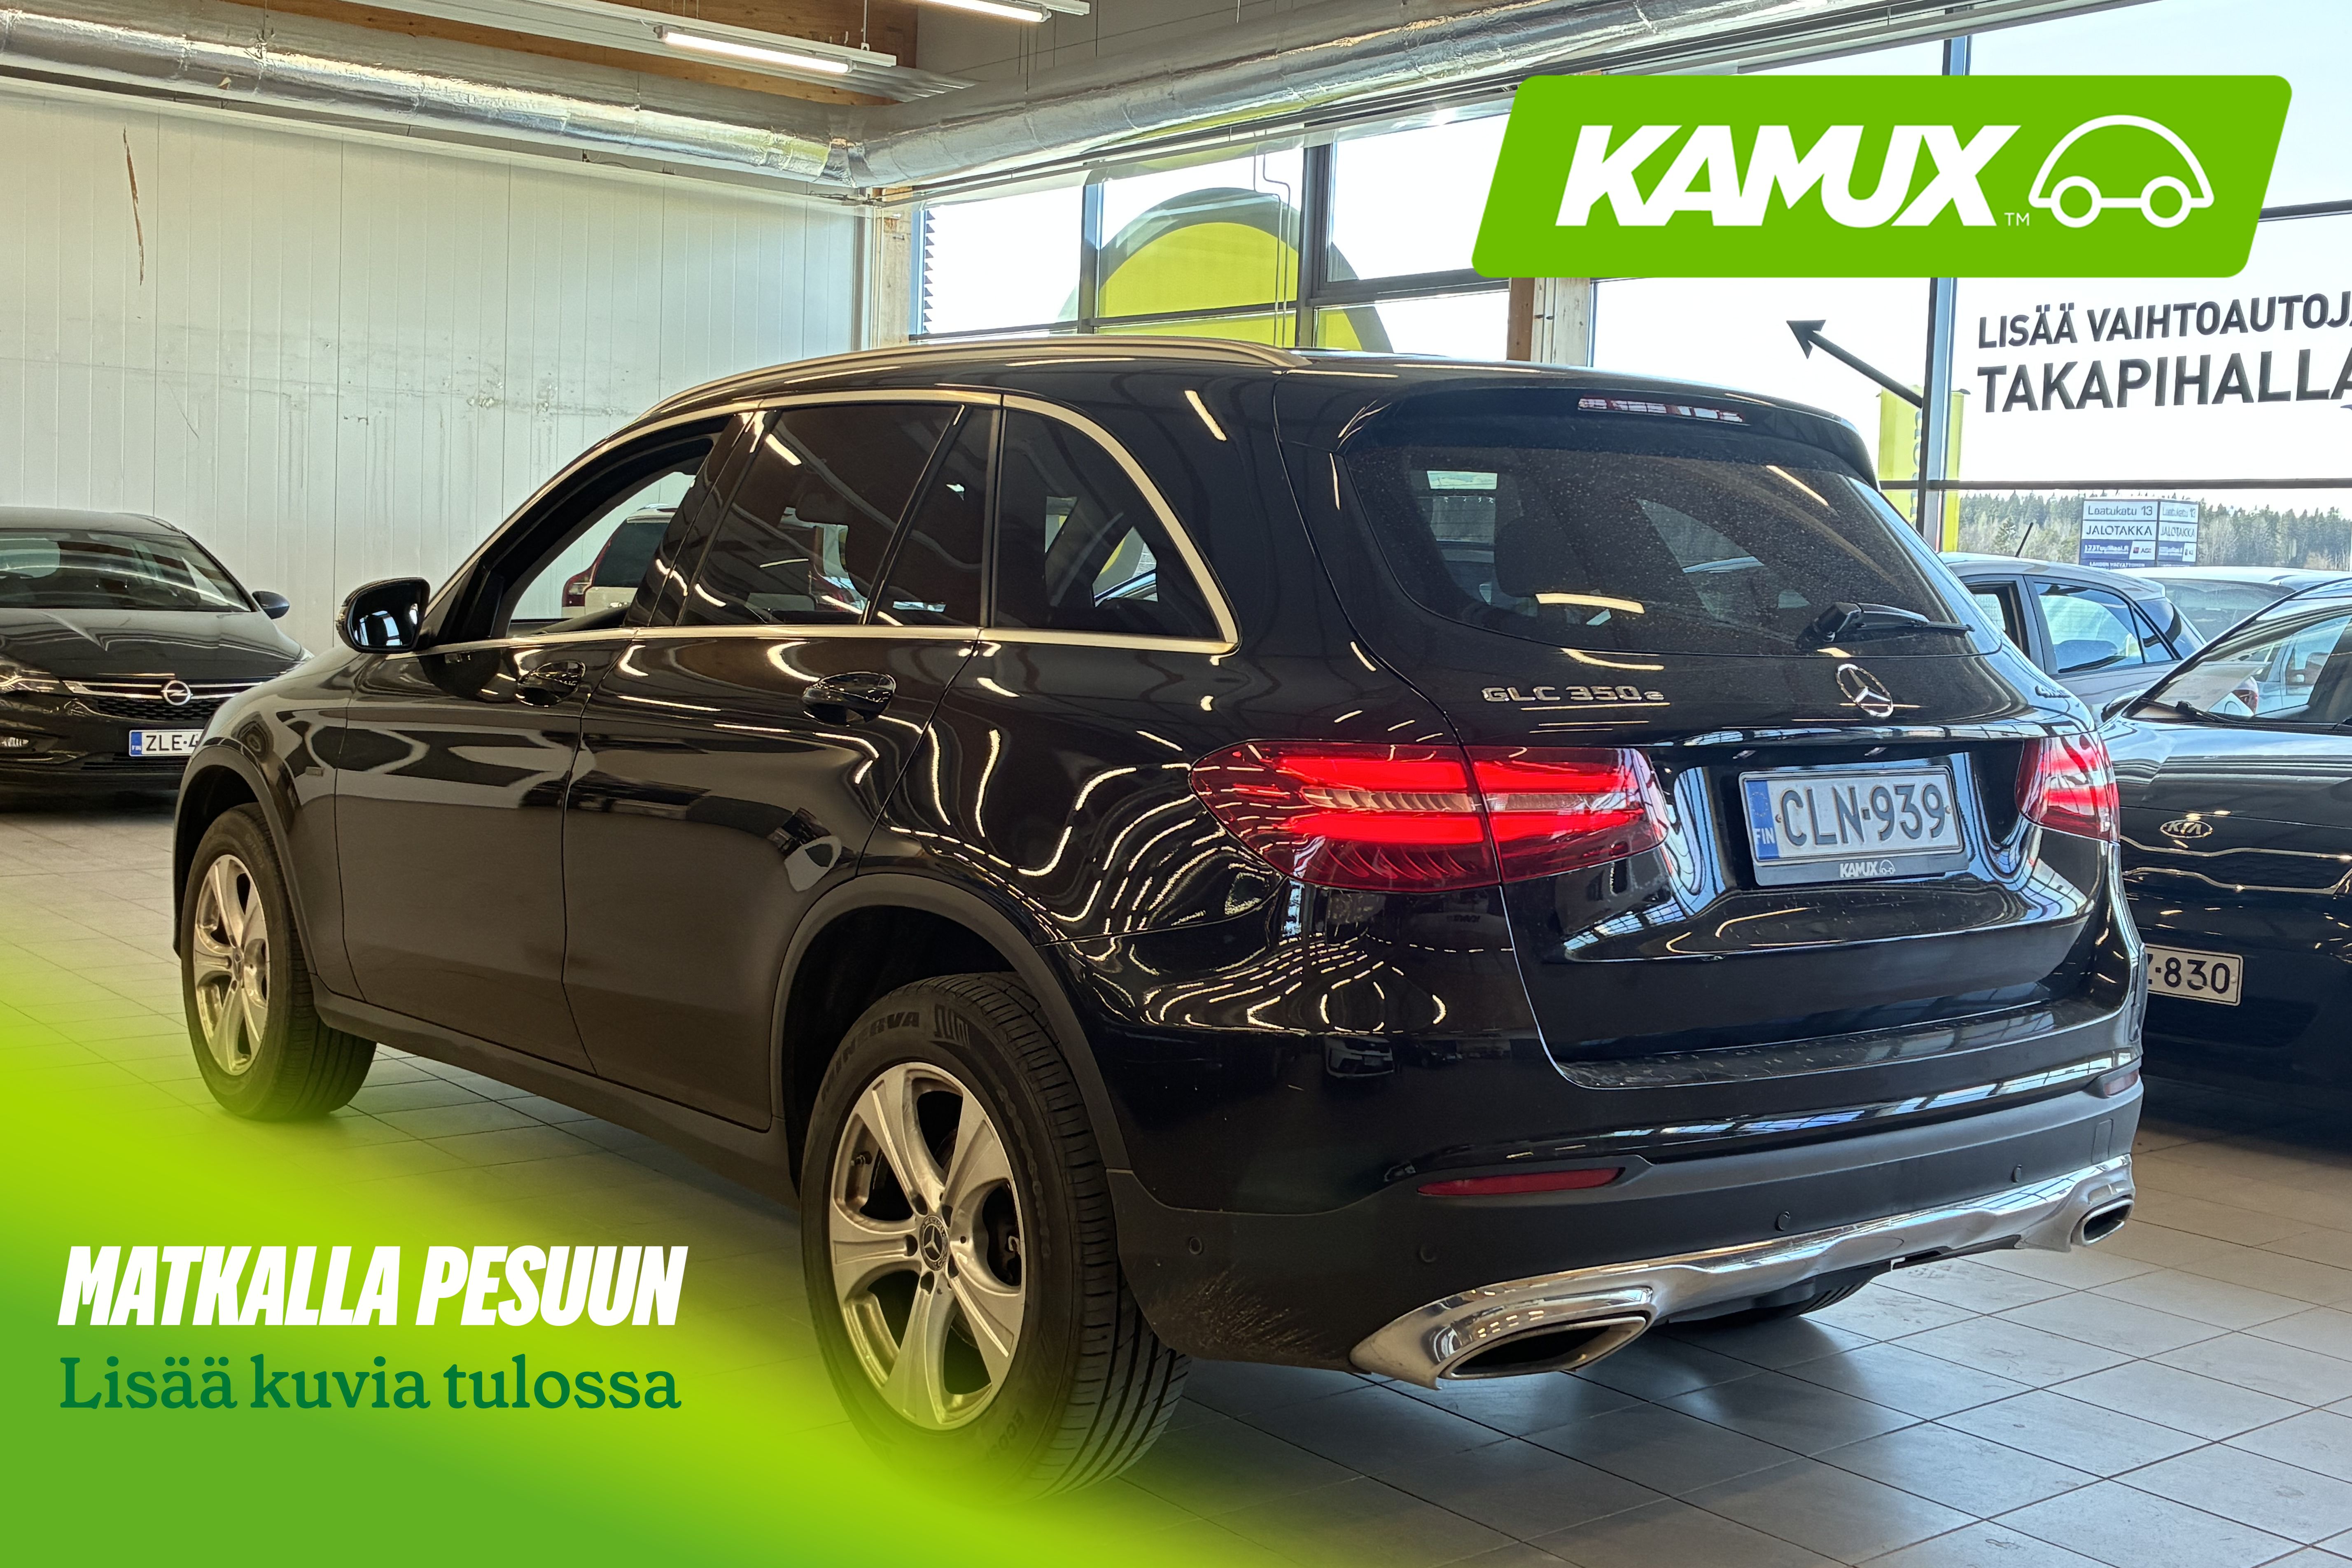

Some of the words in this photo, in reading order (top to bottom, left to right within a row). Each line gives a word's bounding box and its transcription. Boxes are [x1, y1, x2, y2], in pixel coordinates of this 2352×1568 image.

[1978, 303, 2077, 349] LISÄÄ
[2087, 291, 2352, 342] VAIHTOAUTOJ
[2141, 506, 2153, 516] 13
[2086, 525, 2152, 536] JALOTAKKA
[1482, 687, 1560, 702] GLC
[1566, 686, 1664, 701] 350e
[1780, 783, 1946, 847] CLN-939
[2166, 820, 2203, 836] KIA
[1754, 828, 1776, 845] FIN
[1840, 861, 1879, 878] KAMUX
